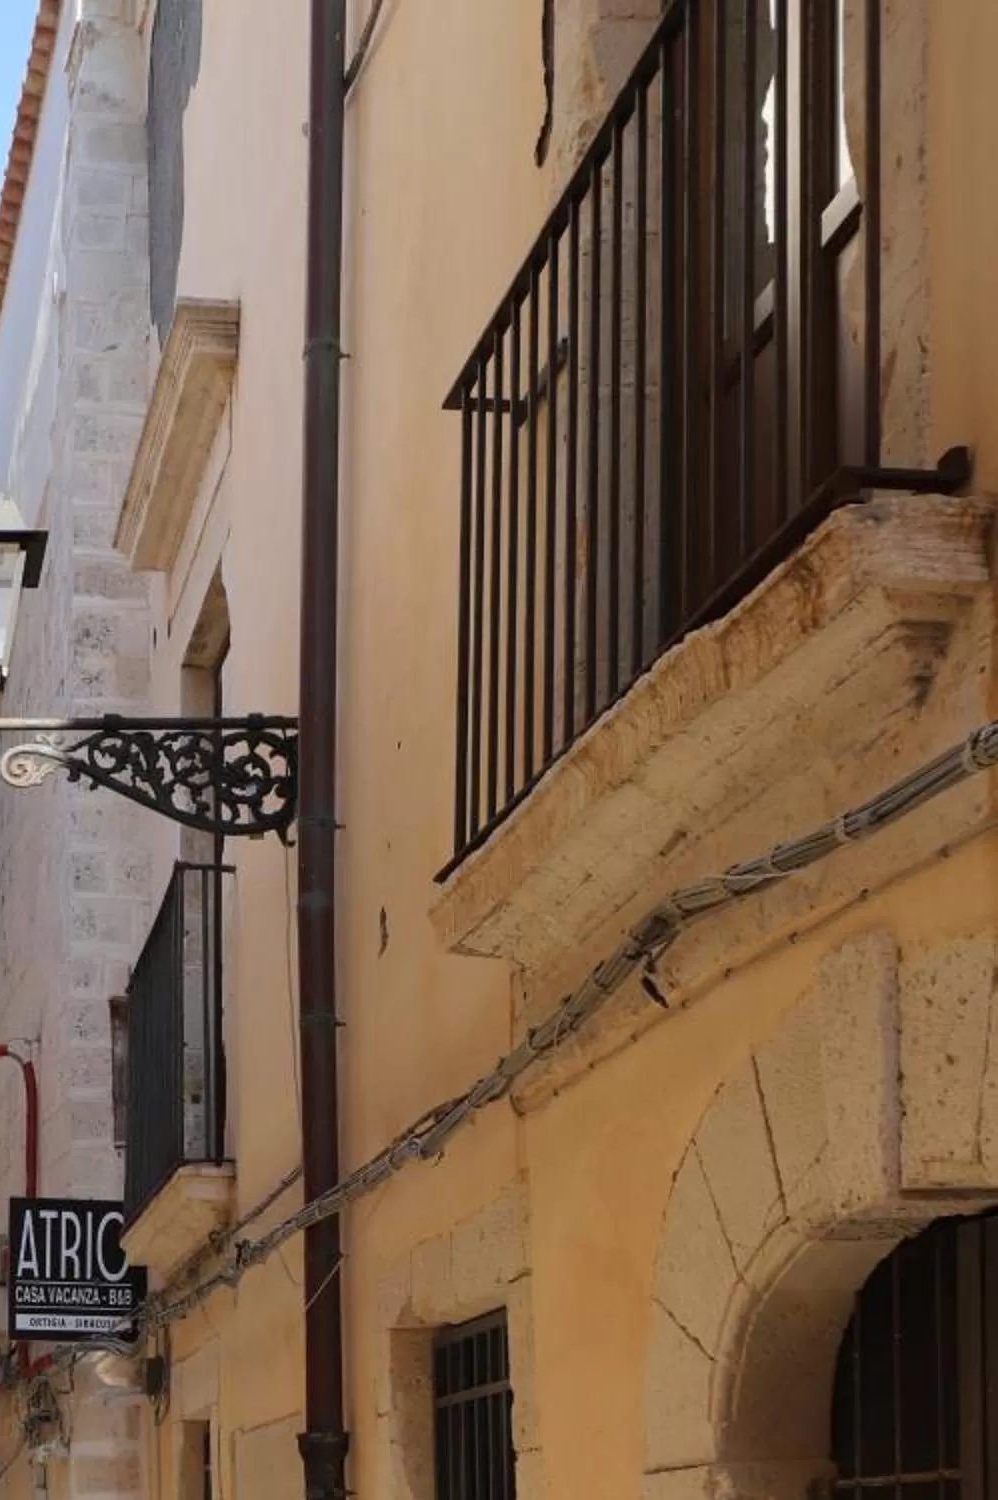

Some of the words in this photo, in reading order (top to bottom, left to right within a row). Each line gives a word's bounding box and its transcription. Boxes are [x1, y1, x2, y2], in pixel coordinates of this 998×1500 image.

[15, 1286, 46, 1303] CASA
[47, 1287, 101, 1305] VACANZA
[109, 1288, 133, 1305] B&B
[29, 1317, 66, 1328] ORTIGIA
